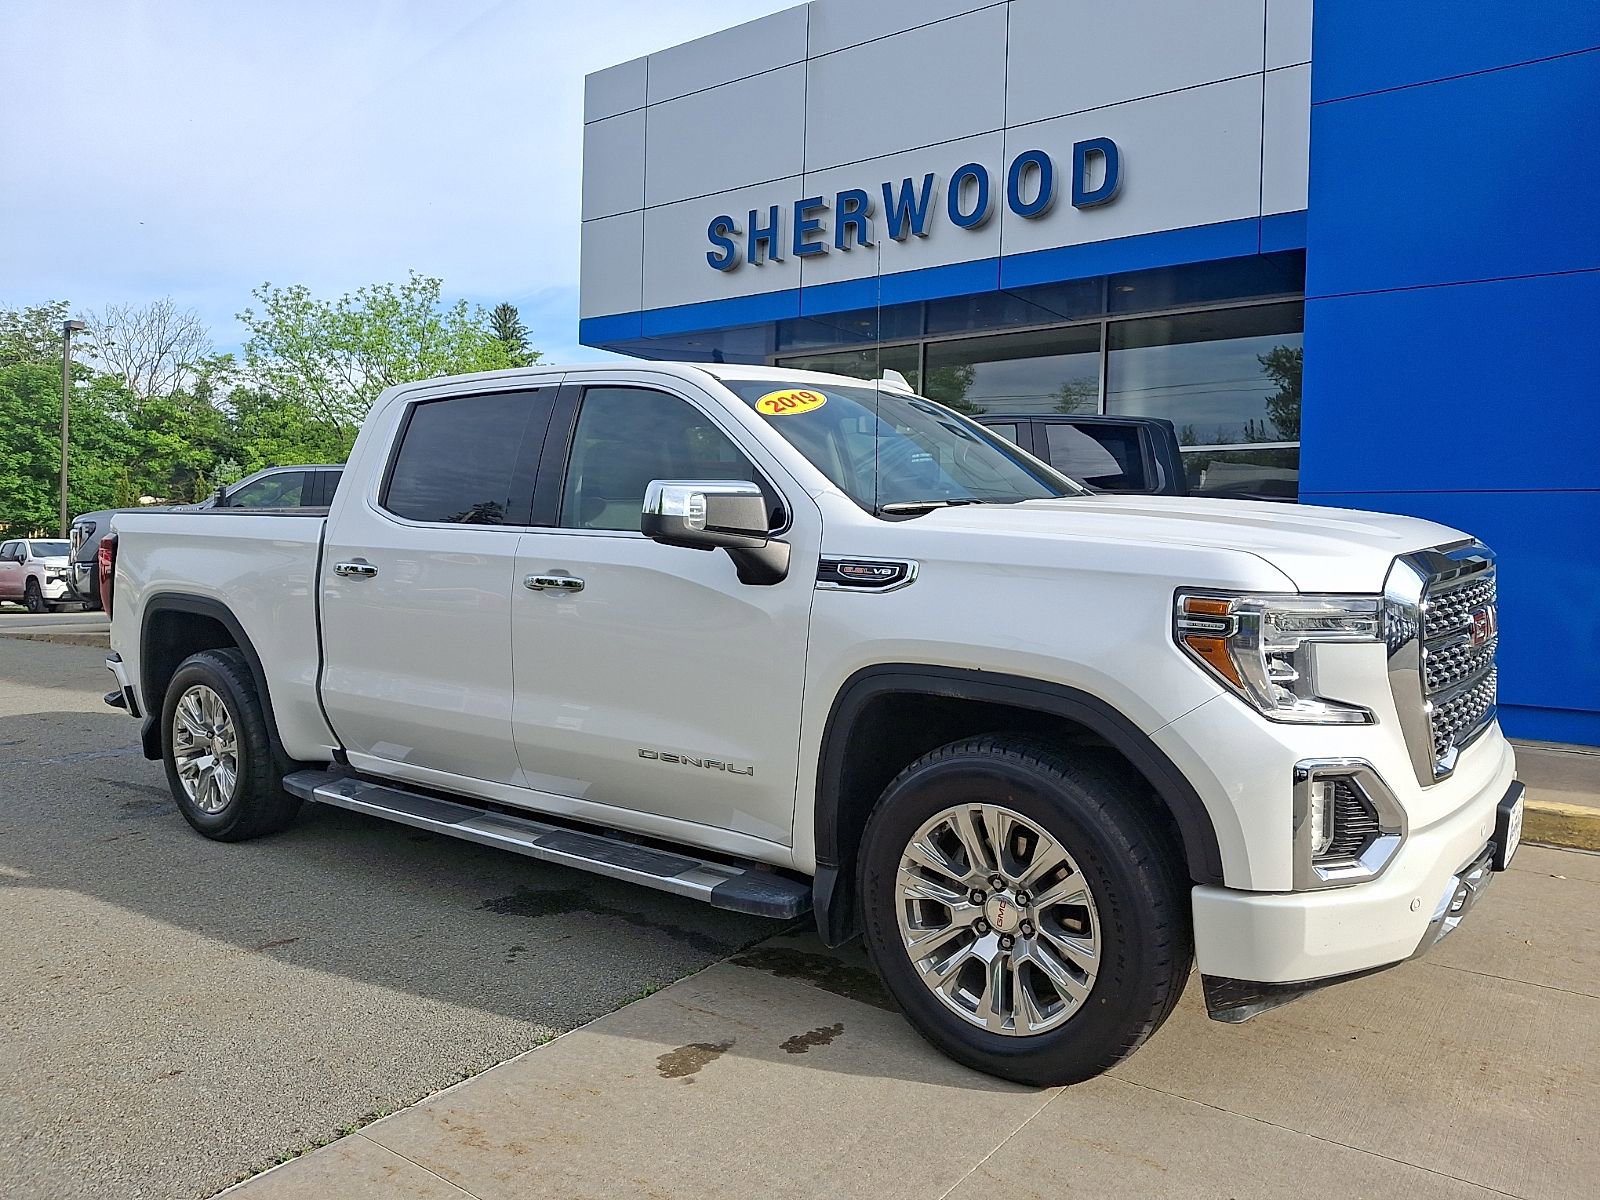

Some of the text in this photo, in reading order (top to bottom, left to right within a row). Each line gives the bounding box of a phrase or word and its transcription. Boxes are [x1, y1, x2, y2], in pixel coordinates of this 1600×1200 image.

[706, 136, 1122, 271] SHERWOOD
[764, 391, 818, 413] 2019
[638, 748, 753, 776] DENALI
[996, 898, 1007, 928] GMC
